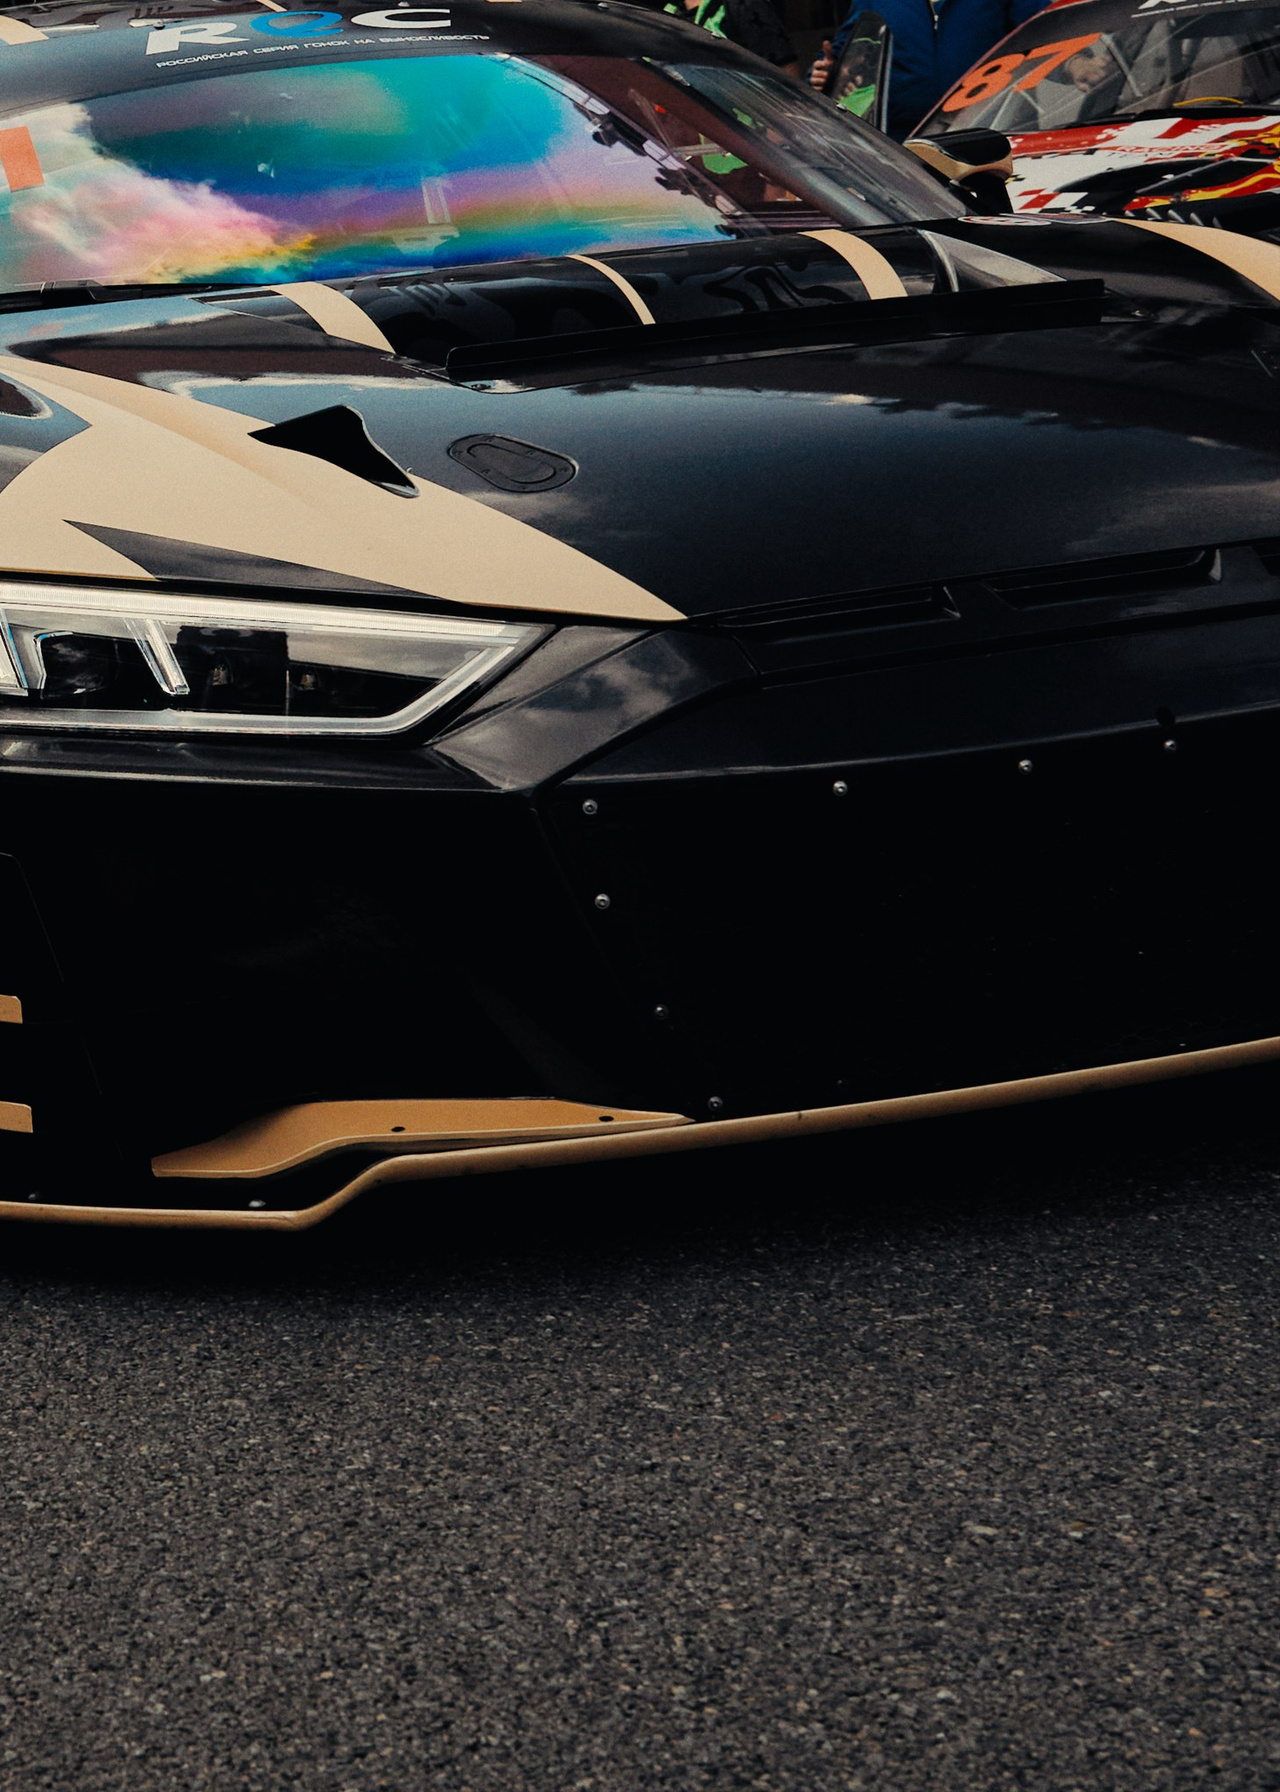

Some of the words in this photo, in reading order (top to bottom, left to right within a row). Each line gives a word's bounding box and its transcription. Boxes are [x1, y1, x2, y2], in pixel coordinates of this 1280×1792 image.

[155, 50, 249, 68] РОССИЙСКАЯ
[253, 44, 299, 55] СЕРИЯ
[303, 39, 351, 49] ГОНОК
[378, 34, 490, 43] ВЫНОСЛИВОСТЬ
[942, 32, 1103, 112] 87
